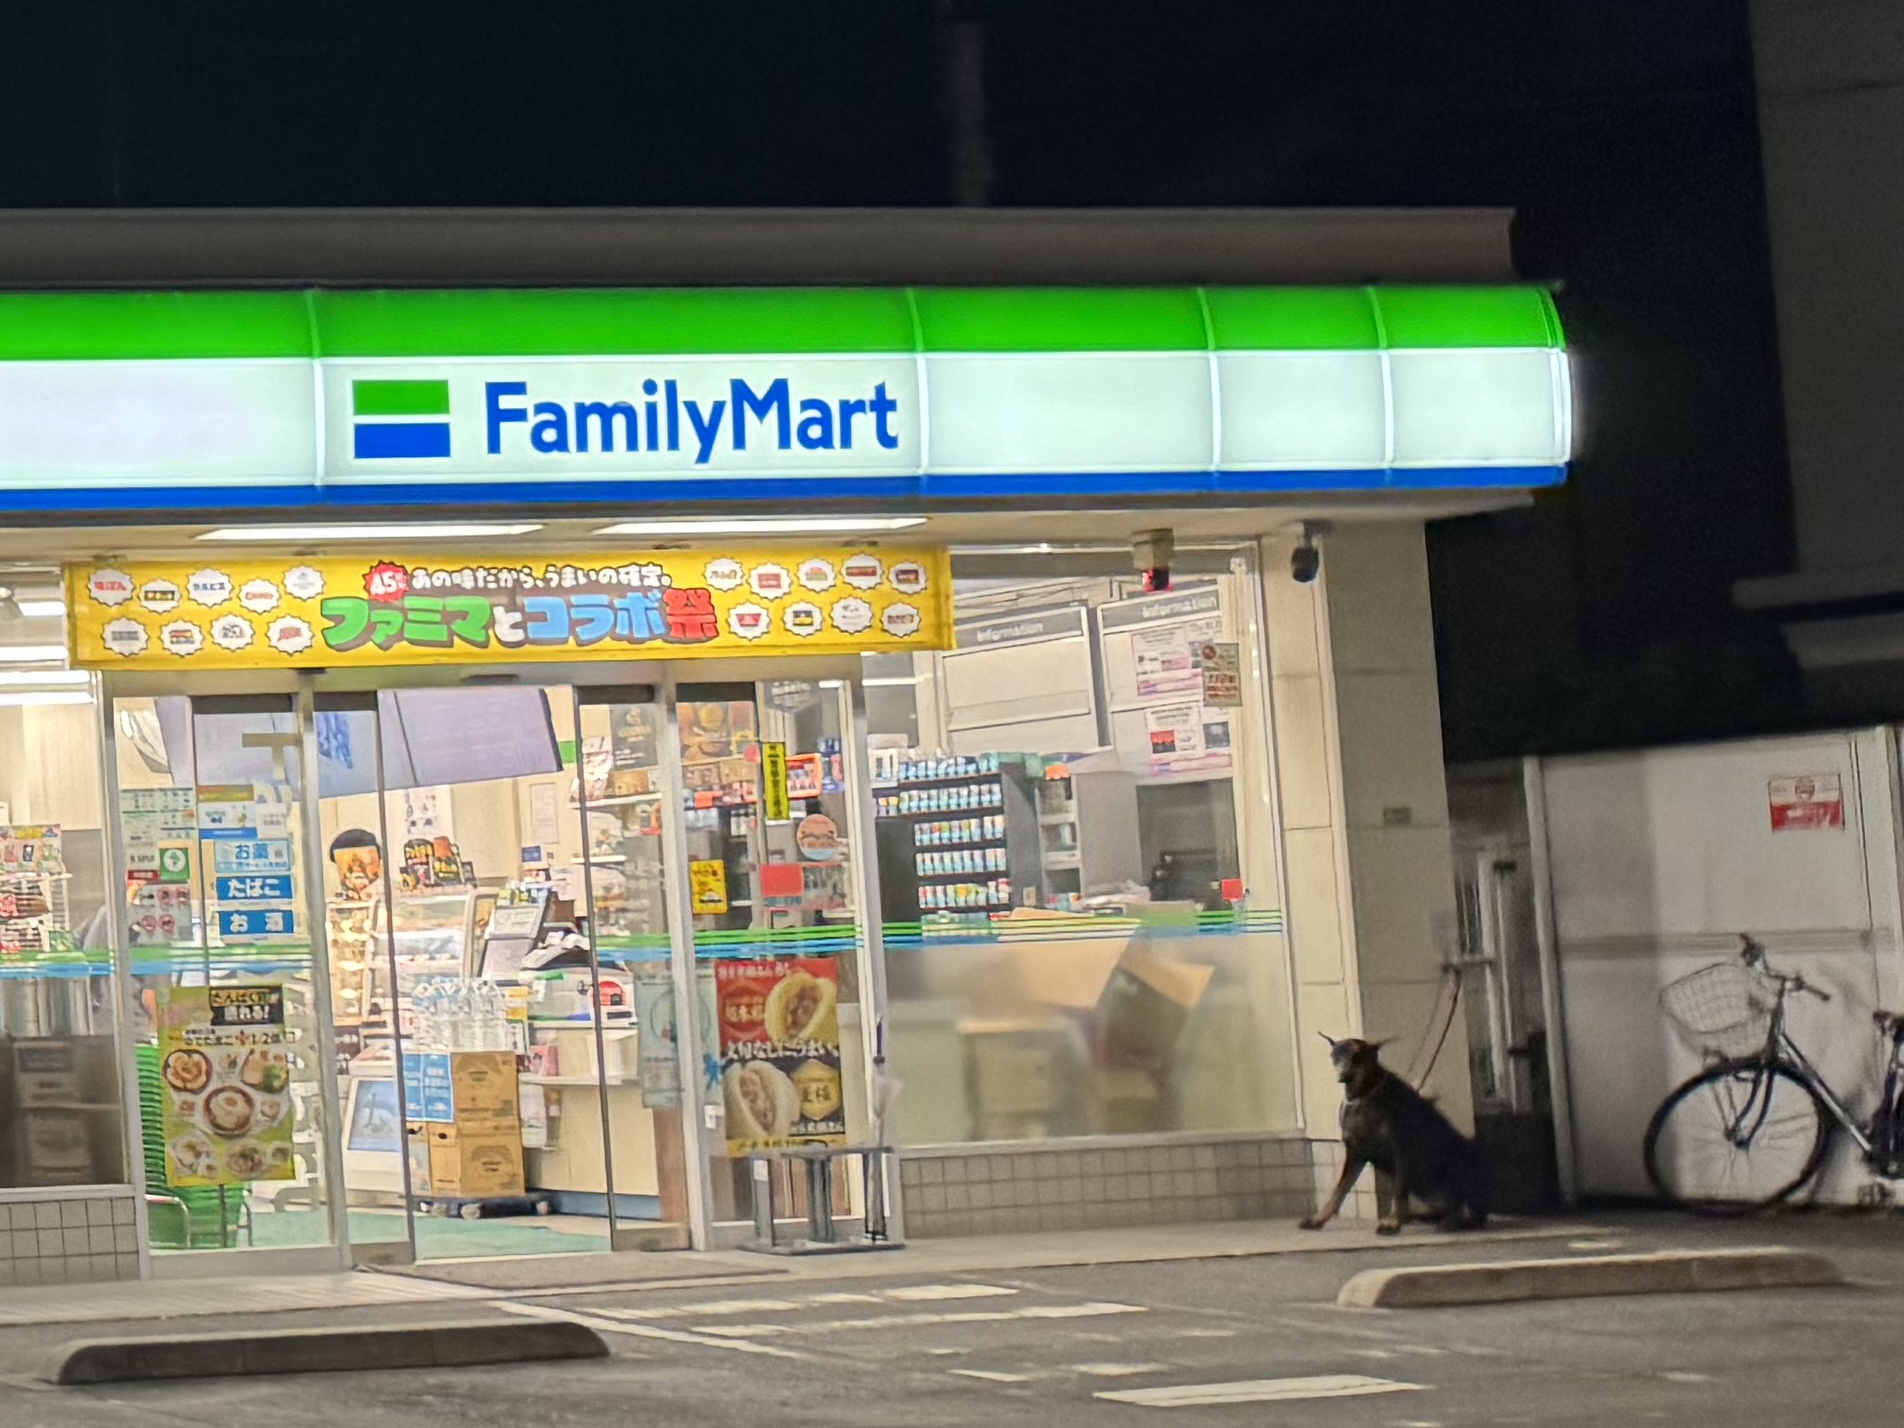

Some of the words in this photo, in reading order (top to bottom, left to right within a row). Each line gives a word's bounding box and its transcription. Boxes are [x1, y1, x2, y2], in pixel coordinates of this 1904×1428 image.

[485, 378, 899, 464] FamilyMart
[411, 565, 672, 590] あの味だから、うまいの確定。
[322, 588, 720, 648] ファミマとコラボ祭
[1142, 594, 1217, 619] Information
[976, 621, 1044, 642] Information
[228, 878, 282, 898] たばこ
